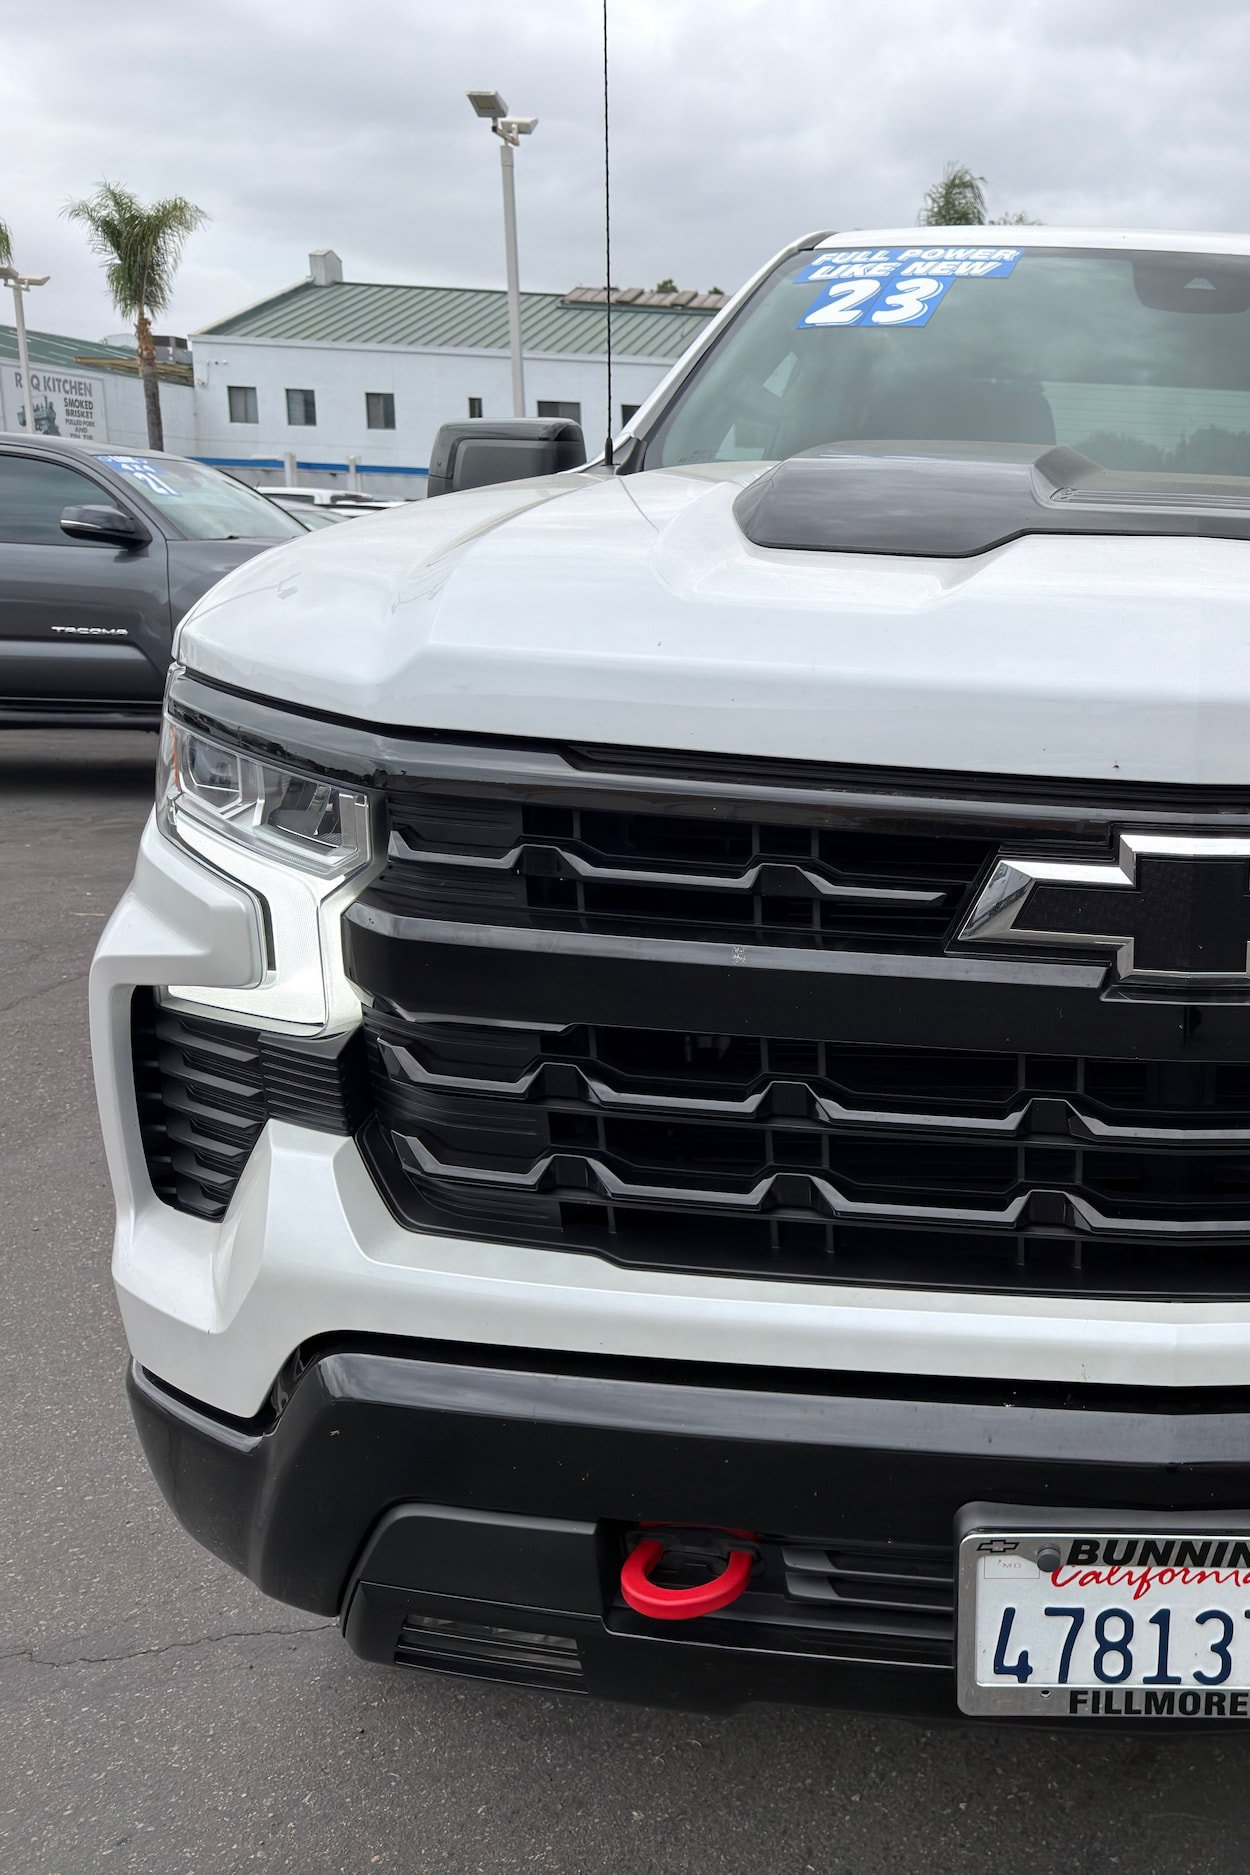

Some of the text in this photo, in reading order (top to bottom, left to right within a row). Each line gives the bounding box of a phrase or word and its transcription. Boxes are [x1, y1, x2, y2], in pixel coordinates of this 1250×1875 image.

[812, 247, 1020, 265] FULL POWER
[807, 260, 1002, 280] LIKE NEW
[804, 277, 944, 327] 23
[15, 372, 93, 397] RQ KITCHEN
[63, 397, 94, 410] SMOKED
[65, 409, 93, 419] BRISKET
[133, 472, 180, 496] 21
[51, 626, 128, 635] TACOMA
[1068, 1690, 1250, 1716] FILLMORE
